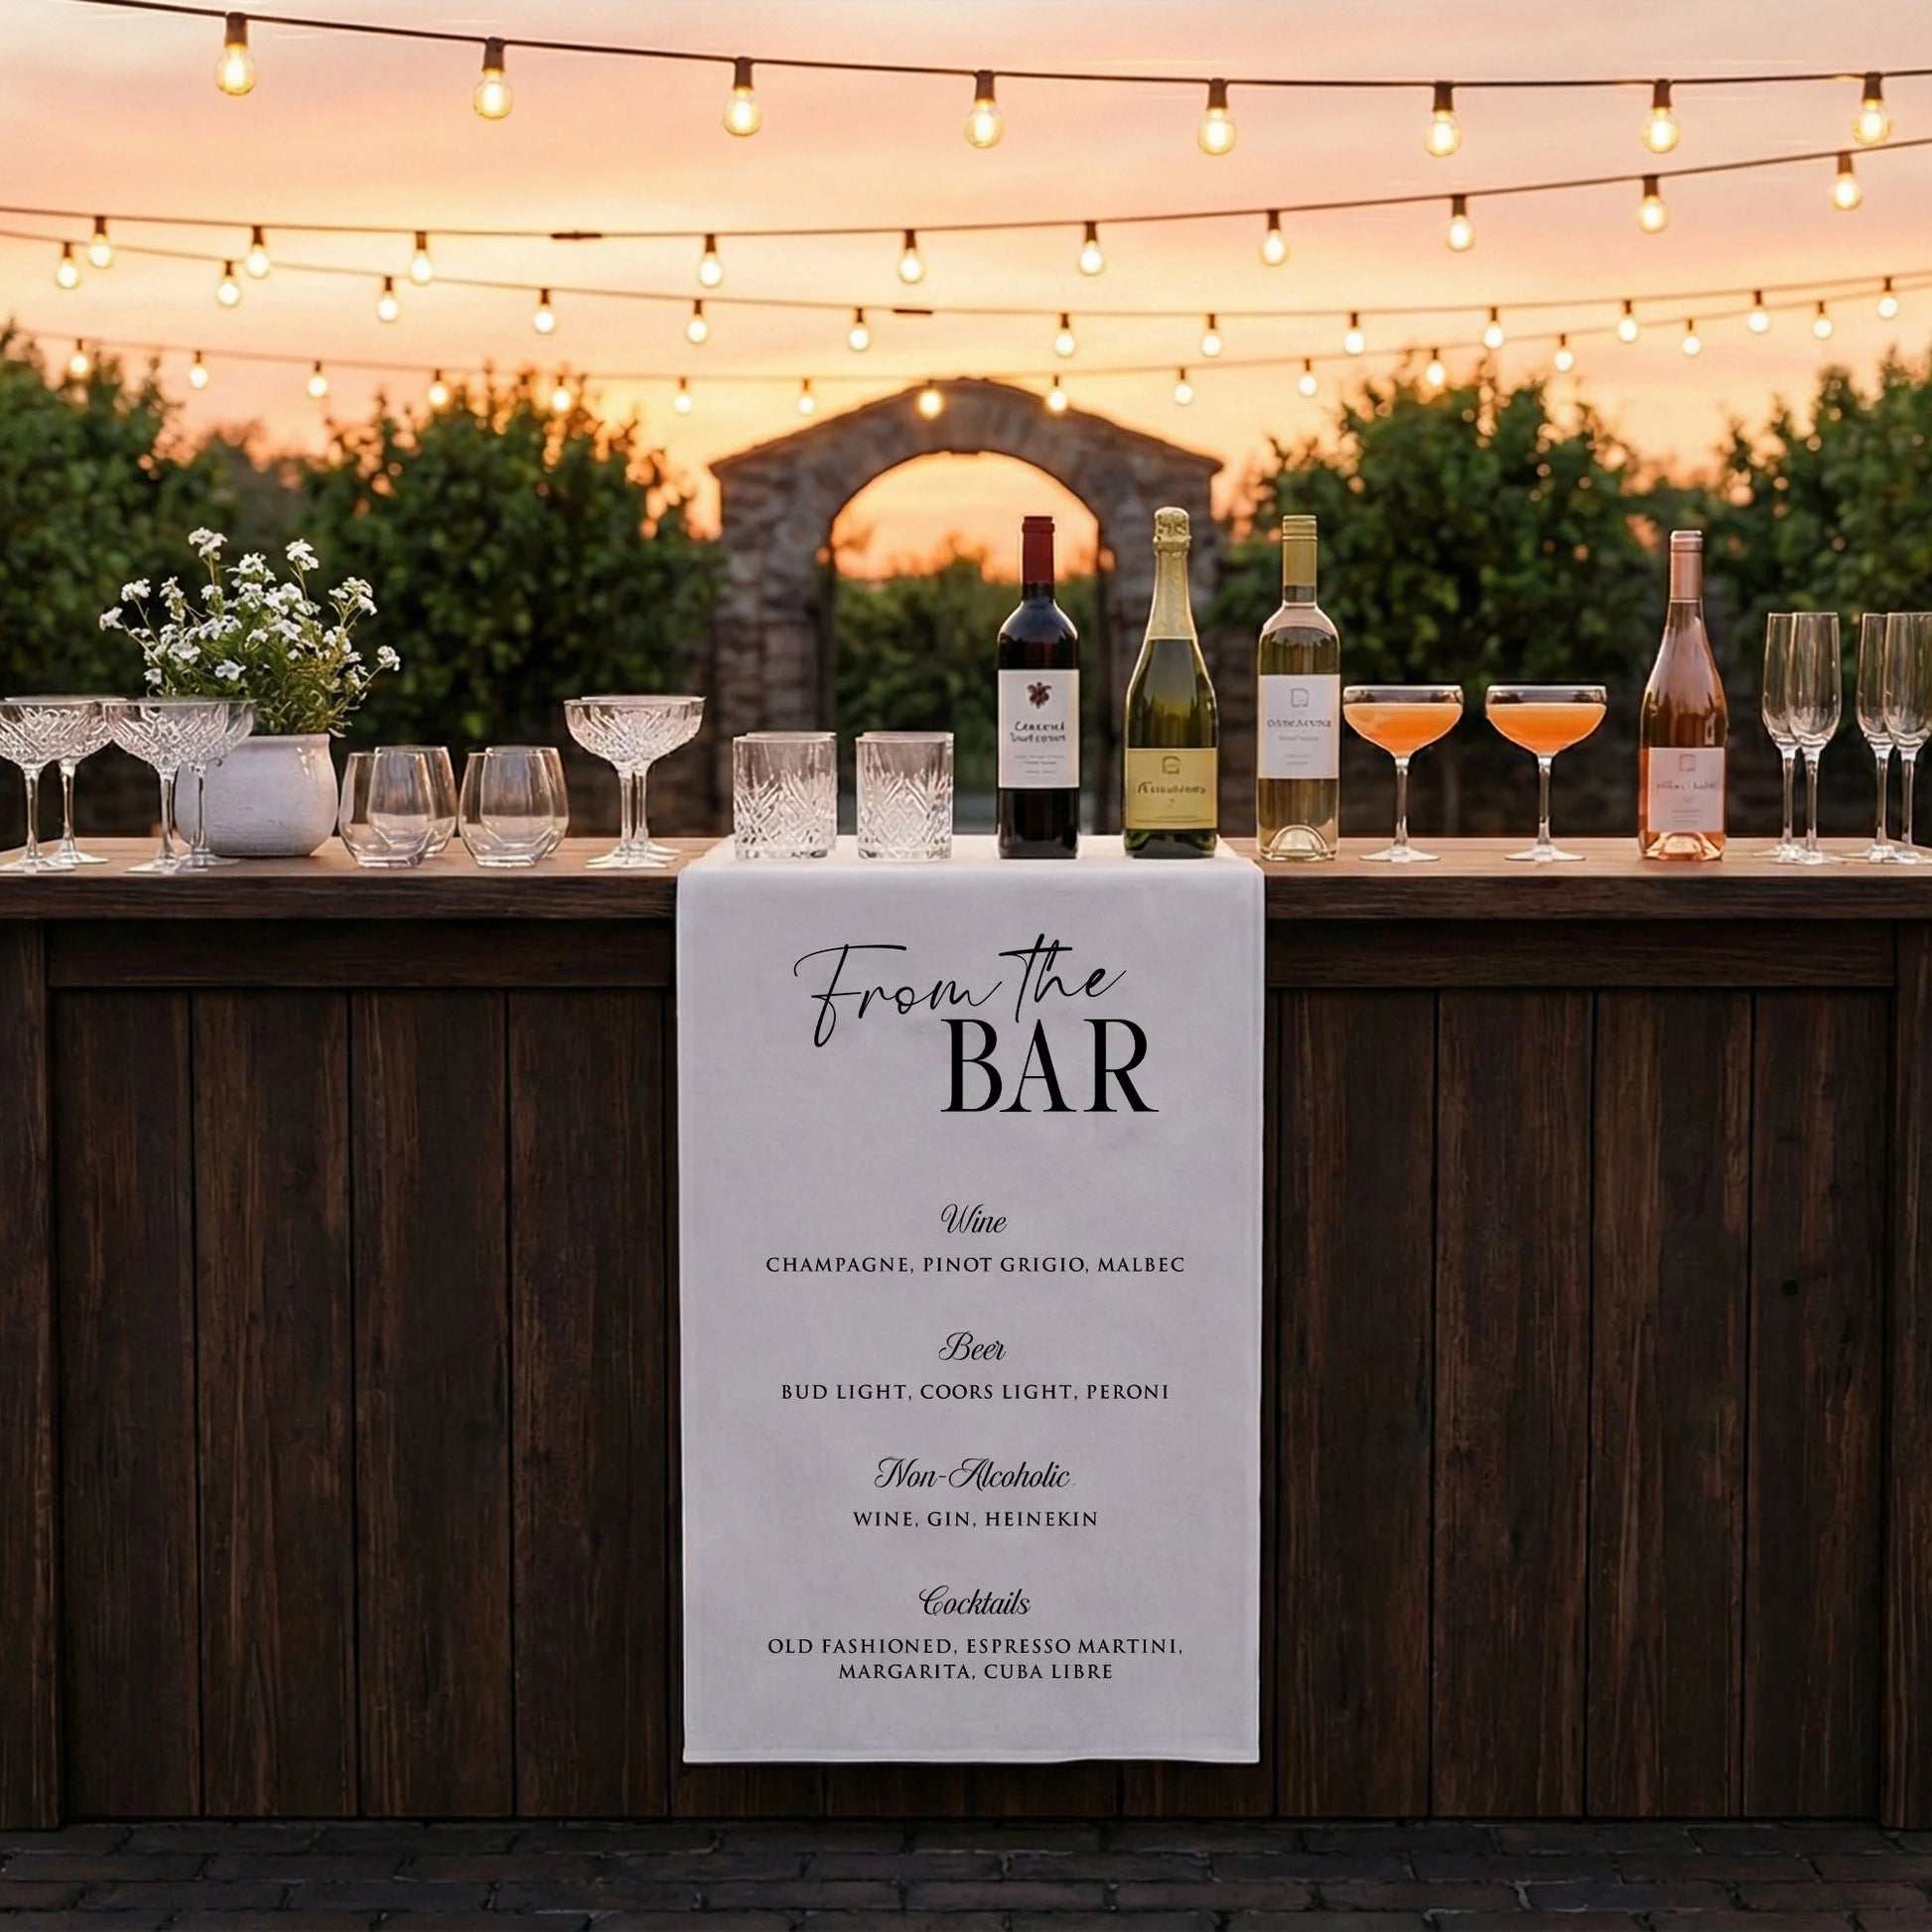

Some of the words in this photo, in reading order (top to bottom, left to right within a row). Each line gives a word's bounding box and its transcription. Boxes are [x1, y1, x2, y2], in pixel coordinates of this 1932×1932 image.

[793, 943, 1003, 1048] From
[998, 932, 1127, 1024] the
[939, 1018, 1160, 1113] BAR
[940, 1202, 1008, 1234] Wine
[765, 1256, 914, 1275] CHAMPAGNE,
[922, 1256, 993, 1274] PINOT
[1000, 1256, 1090, 1275] GRIGIO,
[1096, 1256, 1184, 1274] MALBEC
[938, 1330, 1007, 1361] Beer
[780, 1383, 828, 1401] BUD
[836, 1383, 912, 1402] LIGHT,
[919, 1383, 994, 1401] COORS
[1002, 1383, 1078, 1402] LIGHT,
[1086, 1383, 1169, 1401] PERONI
[873, 1455, 1071, 1492] Non-Alcoholic
[852, 1510, 919, 1529] WINE,
[926, 1510, 977, 1529] GIN,
[985, 1510, 1098, 1528] HEINEKIN
[918, 1585, 1032, 1617] Cocktails
[767, 1638, 814, 1655] OLD
[821, 1638, 958, 1656] FASHIONED,
[966, 1638, 1071, 1655] ESPRESSO
[1076, 1638, 1182, 1656] MARTINI,
[838, 1663, 976, 1681] MARGARITA,
[983, 1663, 1044, 1680] CUBA
[1050, 1663, 1113, 1680] LIBRE
